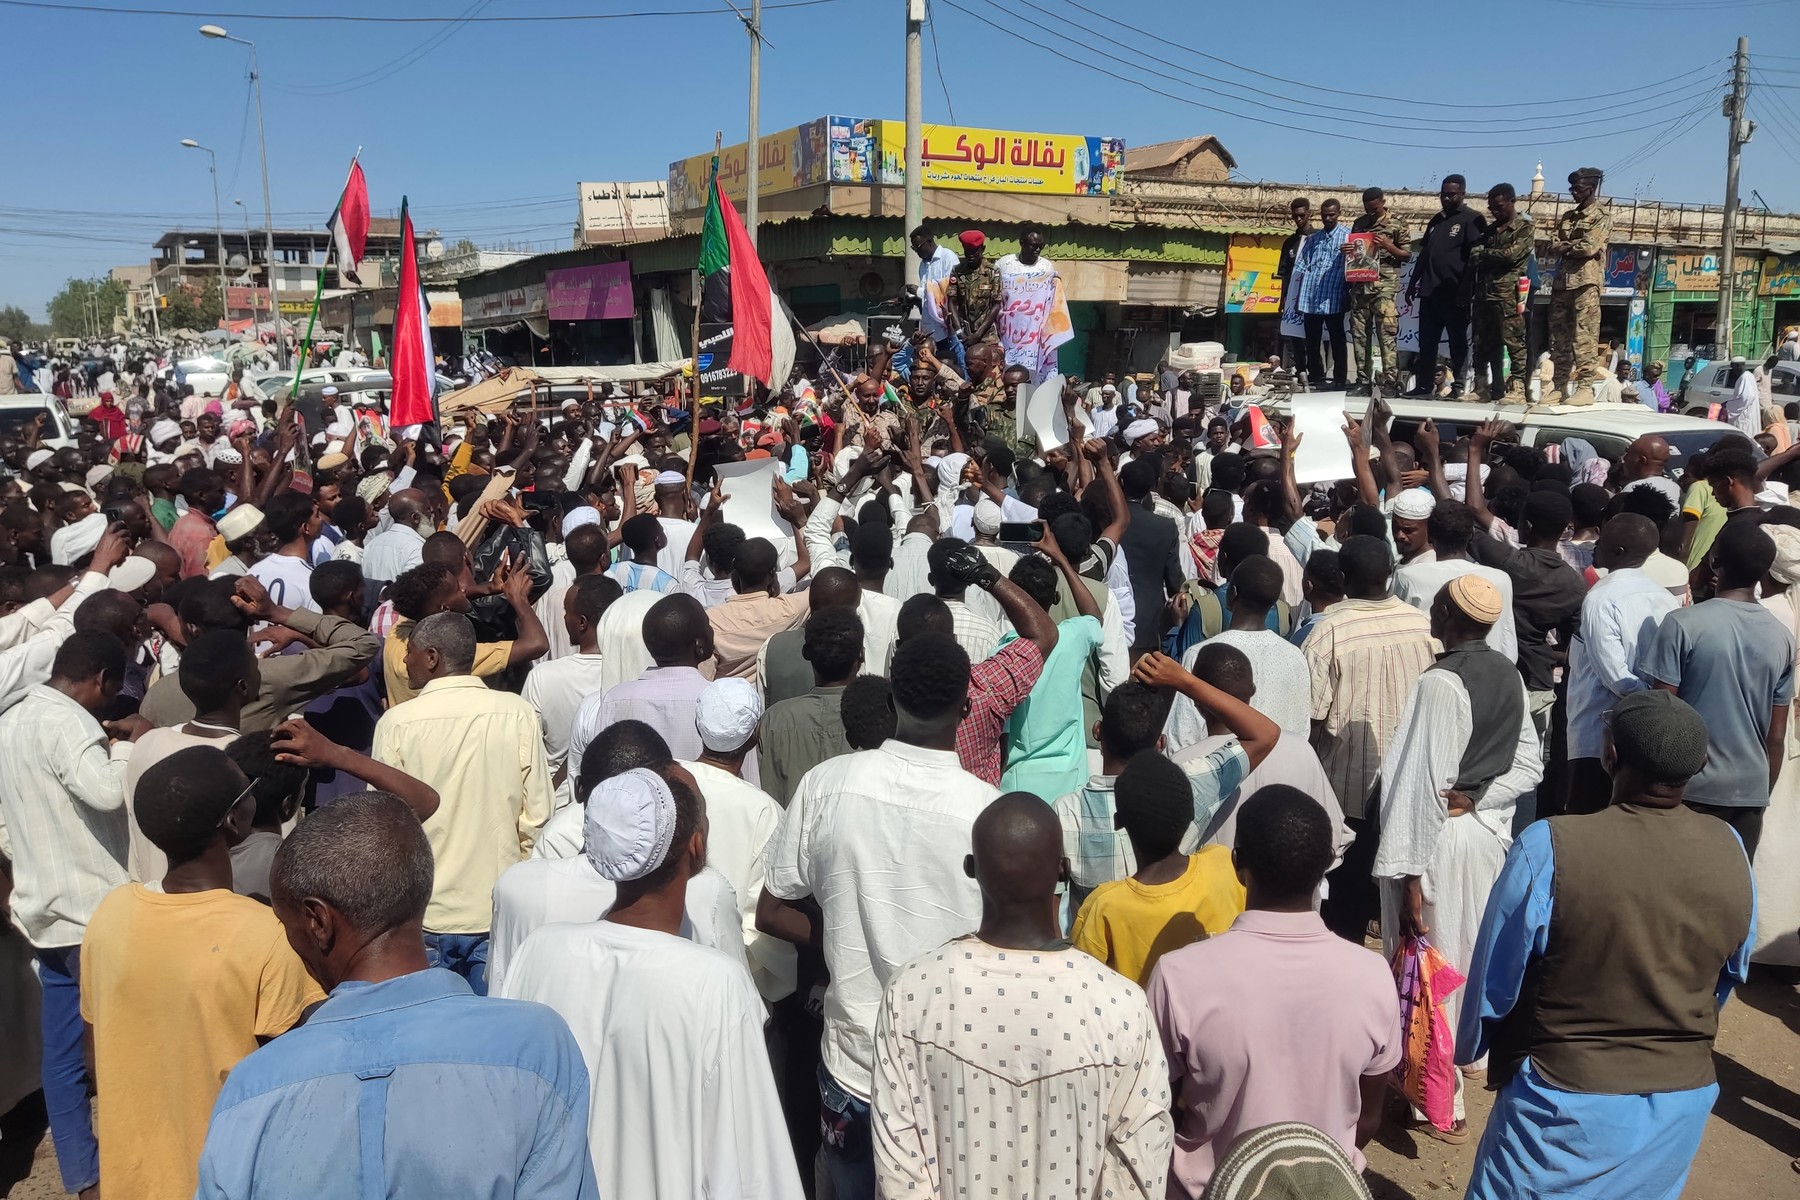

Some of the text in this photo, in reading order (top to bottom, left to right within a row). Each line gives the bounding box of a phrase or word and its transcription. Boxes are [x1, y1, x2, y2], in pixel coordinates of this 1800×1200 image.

[758, 139, 786, 173] بقال
[903, 134, 1065, 175] بقالة الوكي
[927, 170, 950, 181] مشروبات
[963, 173, 982, 182] منتجات
[1010, 175, 1027, 186] منتجات
[588, 187, 665, 204] صيدلية الأطباء
